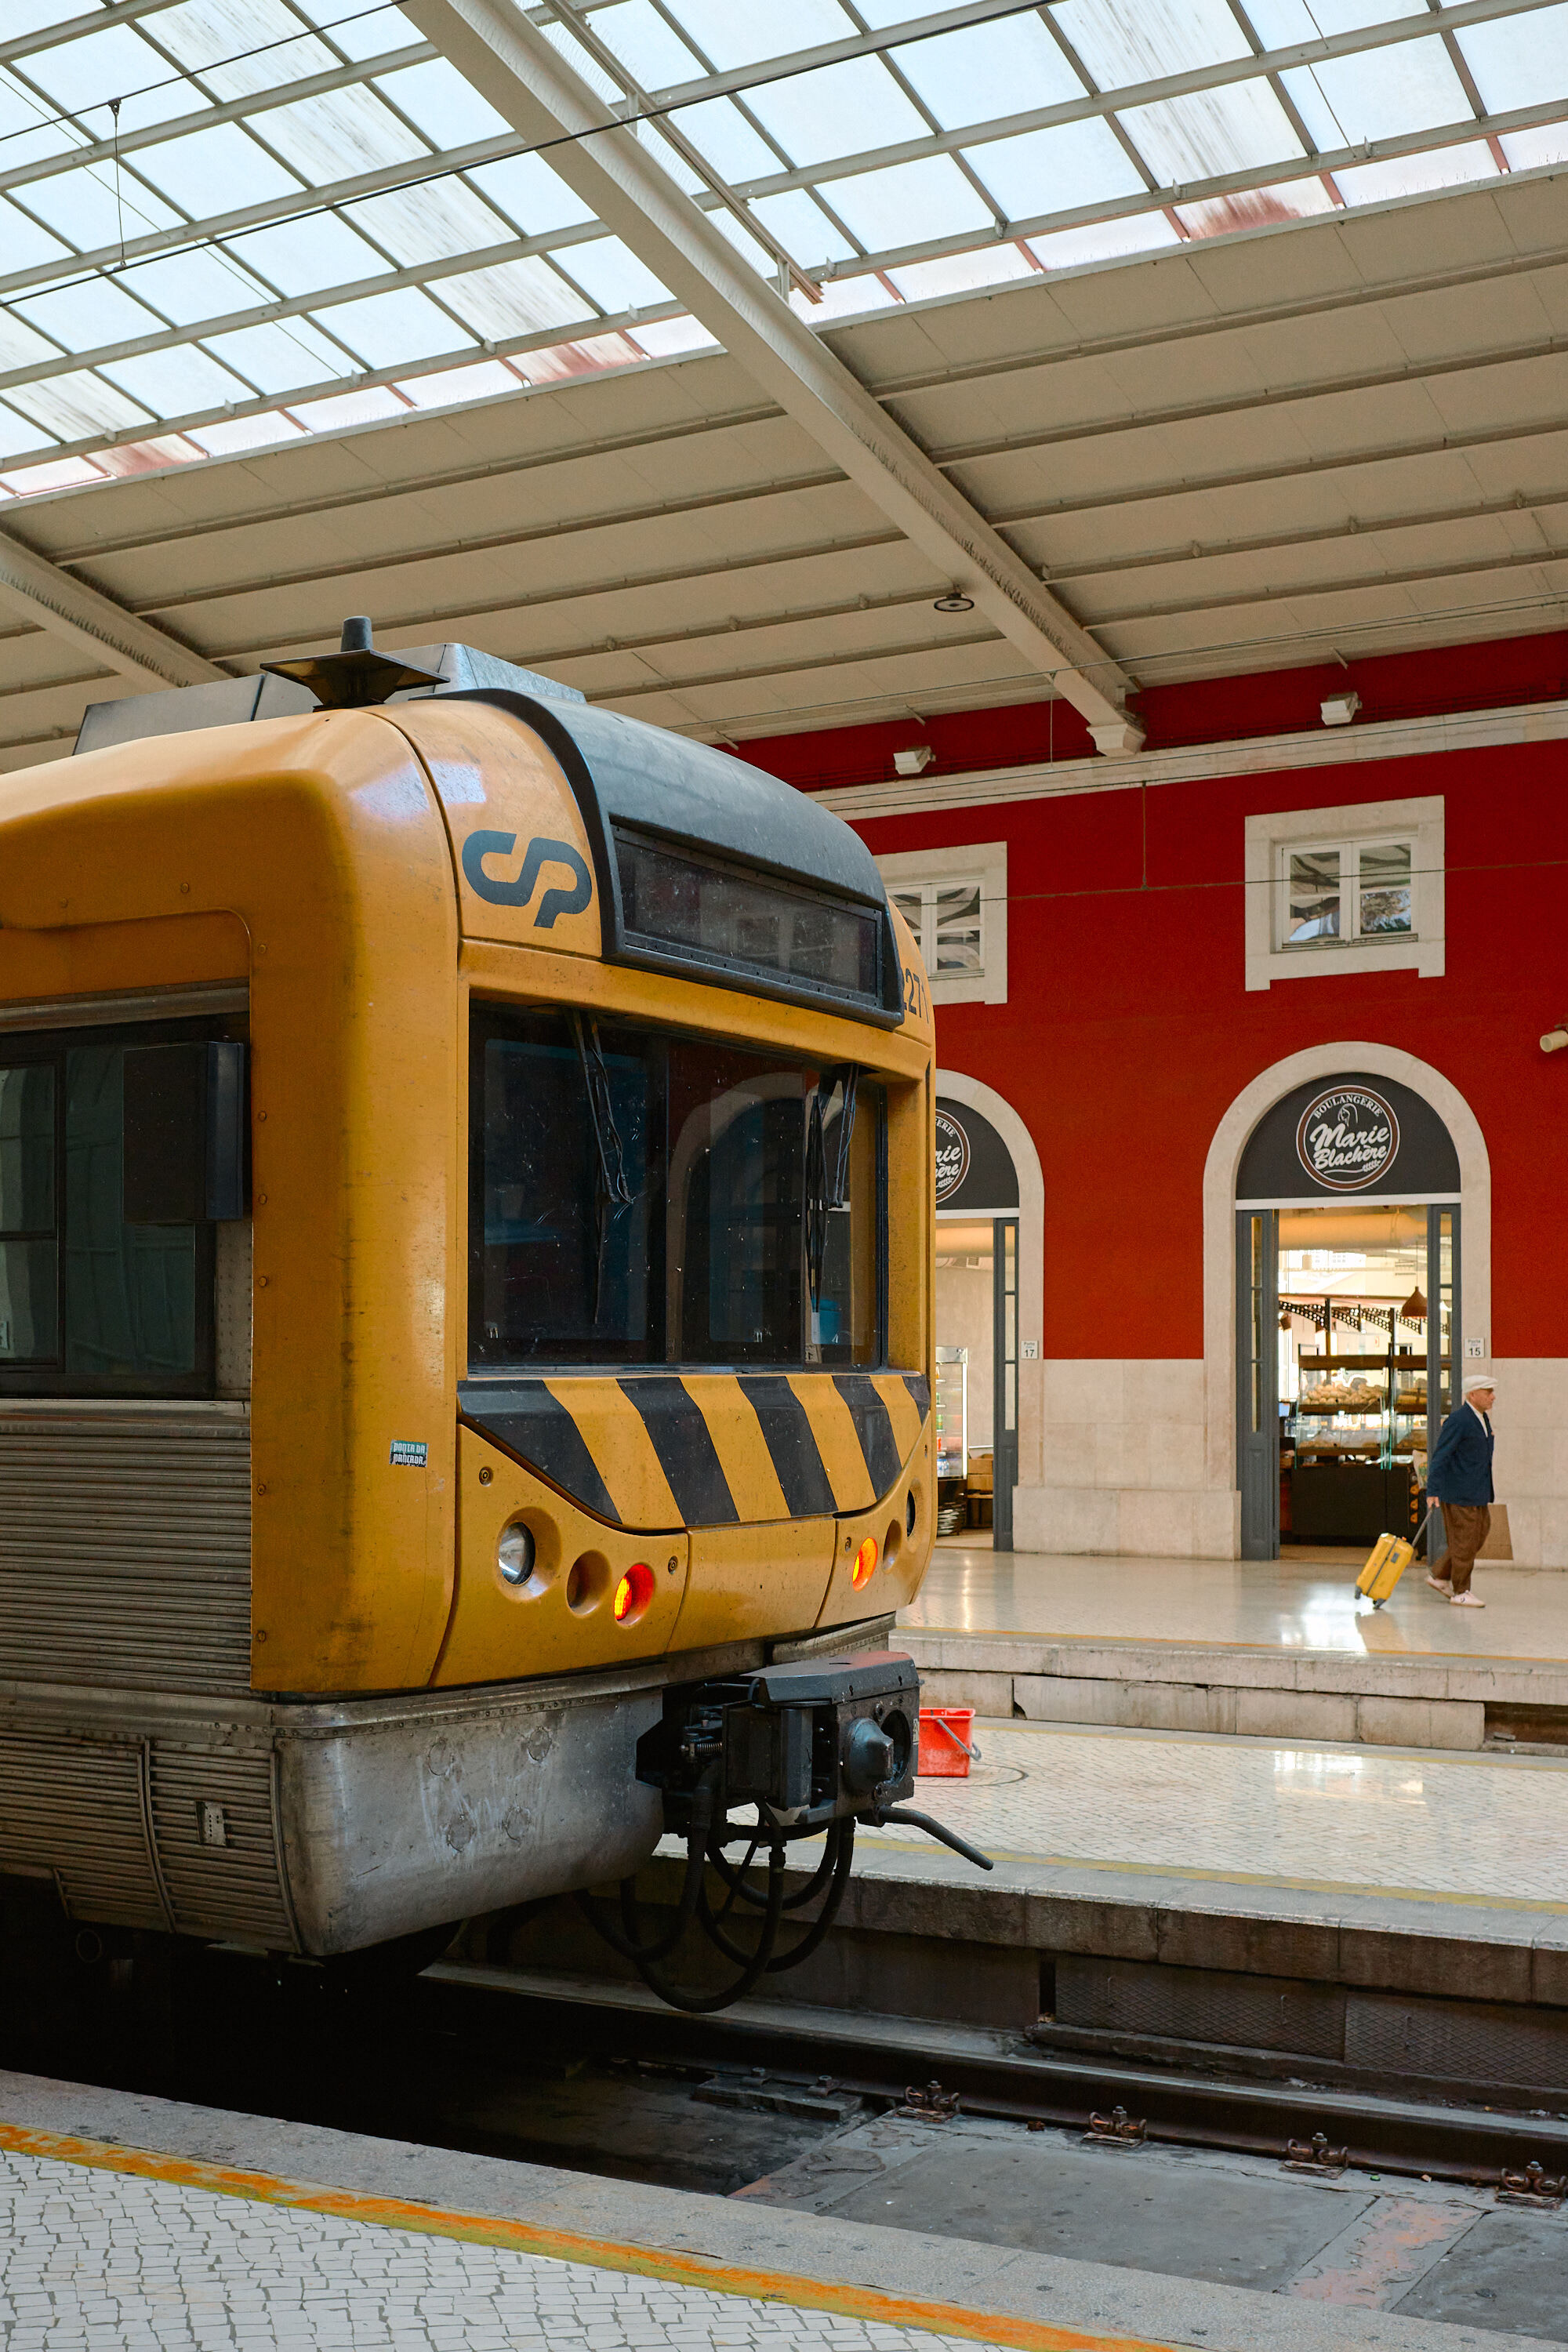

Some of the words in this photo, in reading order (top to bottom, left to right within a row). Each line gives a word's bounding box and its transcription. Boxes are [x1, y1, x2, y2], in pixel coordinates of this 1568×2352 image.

[462, 829, 593, 928] CP
[903, 967, 929, 1024] 271
[1313, 1094, 1382, 1119] BOULANGERIE
[1309, 1123, 1389, 1151] Marie
[1313, 1145, 1387, 1170] Blachère
[1025, 1348, 1035, 1357] 17
[1468, 1347, 1481, 1356] 15
